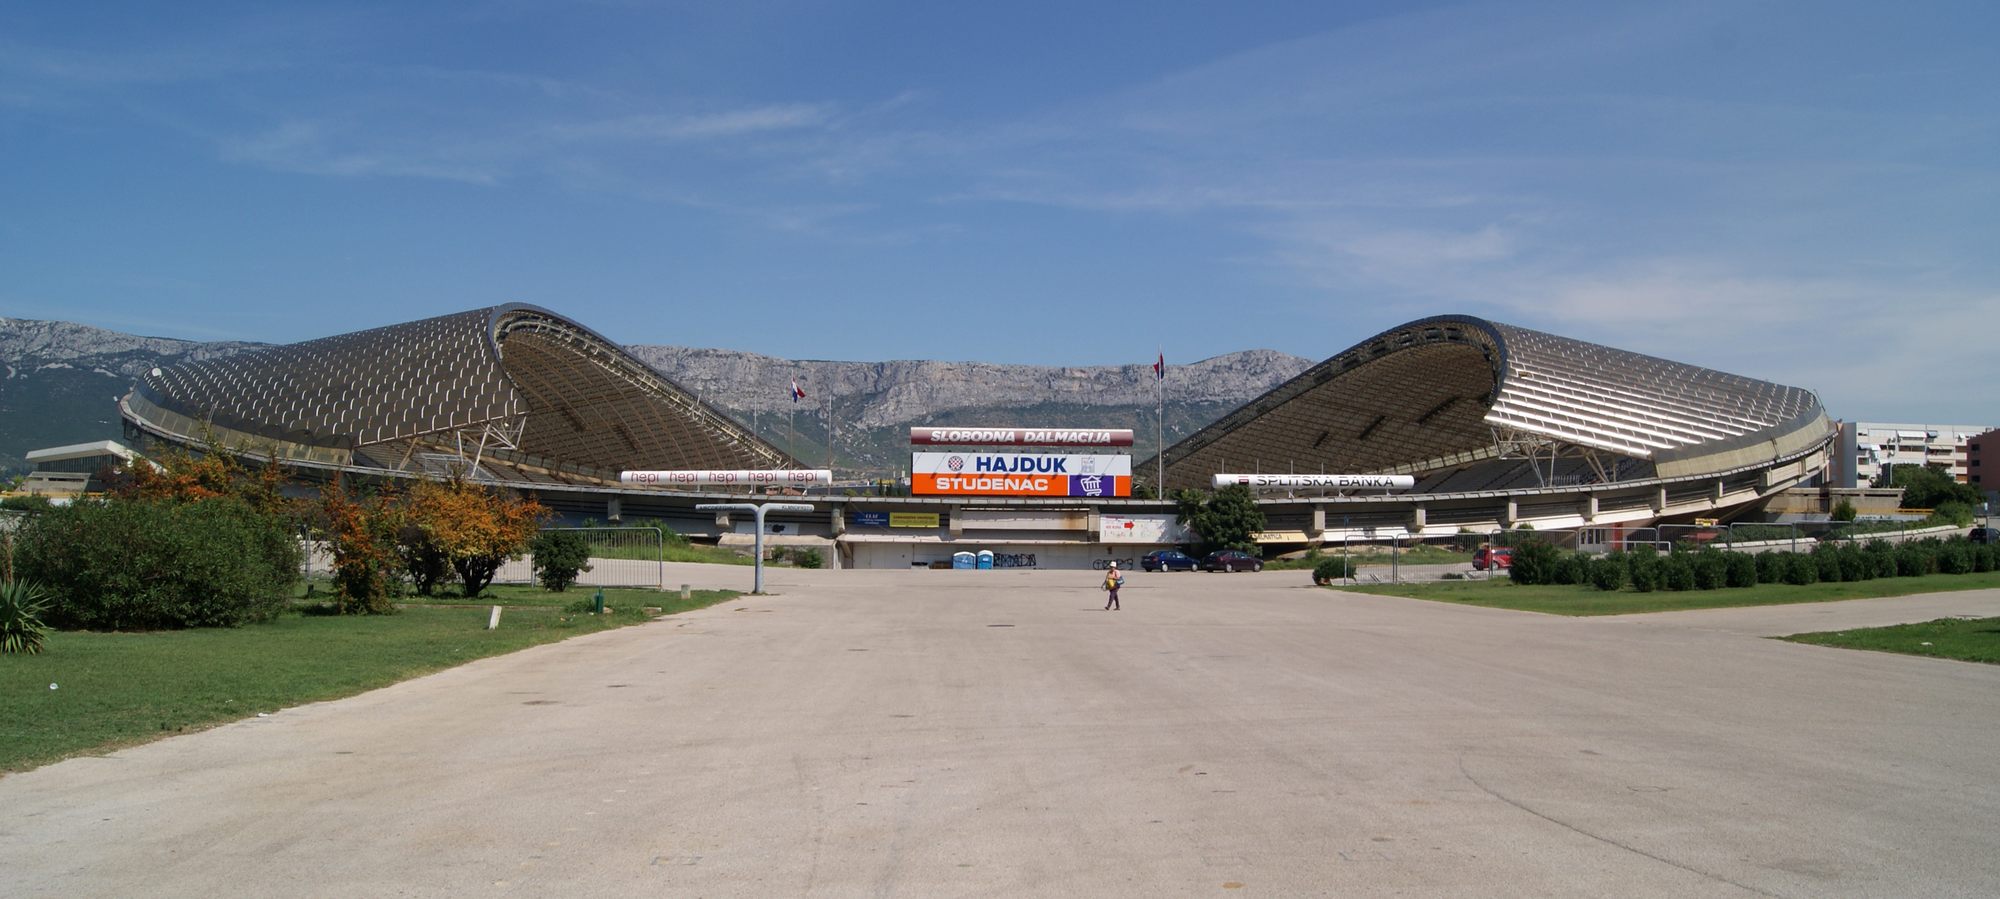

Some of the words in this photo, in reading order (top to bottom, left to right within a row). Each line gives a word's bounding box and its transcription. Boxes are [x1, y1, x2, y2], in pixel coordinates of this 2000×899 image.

[931, 431, 1015, 442] SLOBODNA
[1024, 431, 1111, 442] DALMACIJA
[976, 456, 1067, 473] HAJDUK
[631, 472, 659, 484] hepi
[669, 472, 698, 484] hepi
[708, 472, 738, 484] hepi
[748, 471, 777, 483] hepi
[788, 471, 817, 483] hepi
[1256, 476, 1334, 487] SPLITSKA
[1339, 476, 1394, 487] BANKA
[936, 478, 1048, 491] STUDENAC
